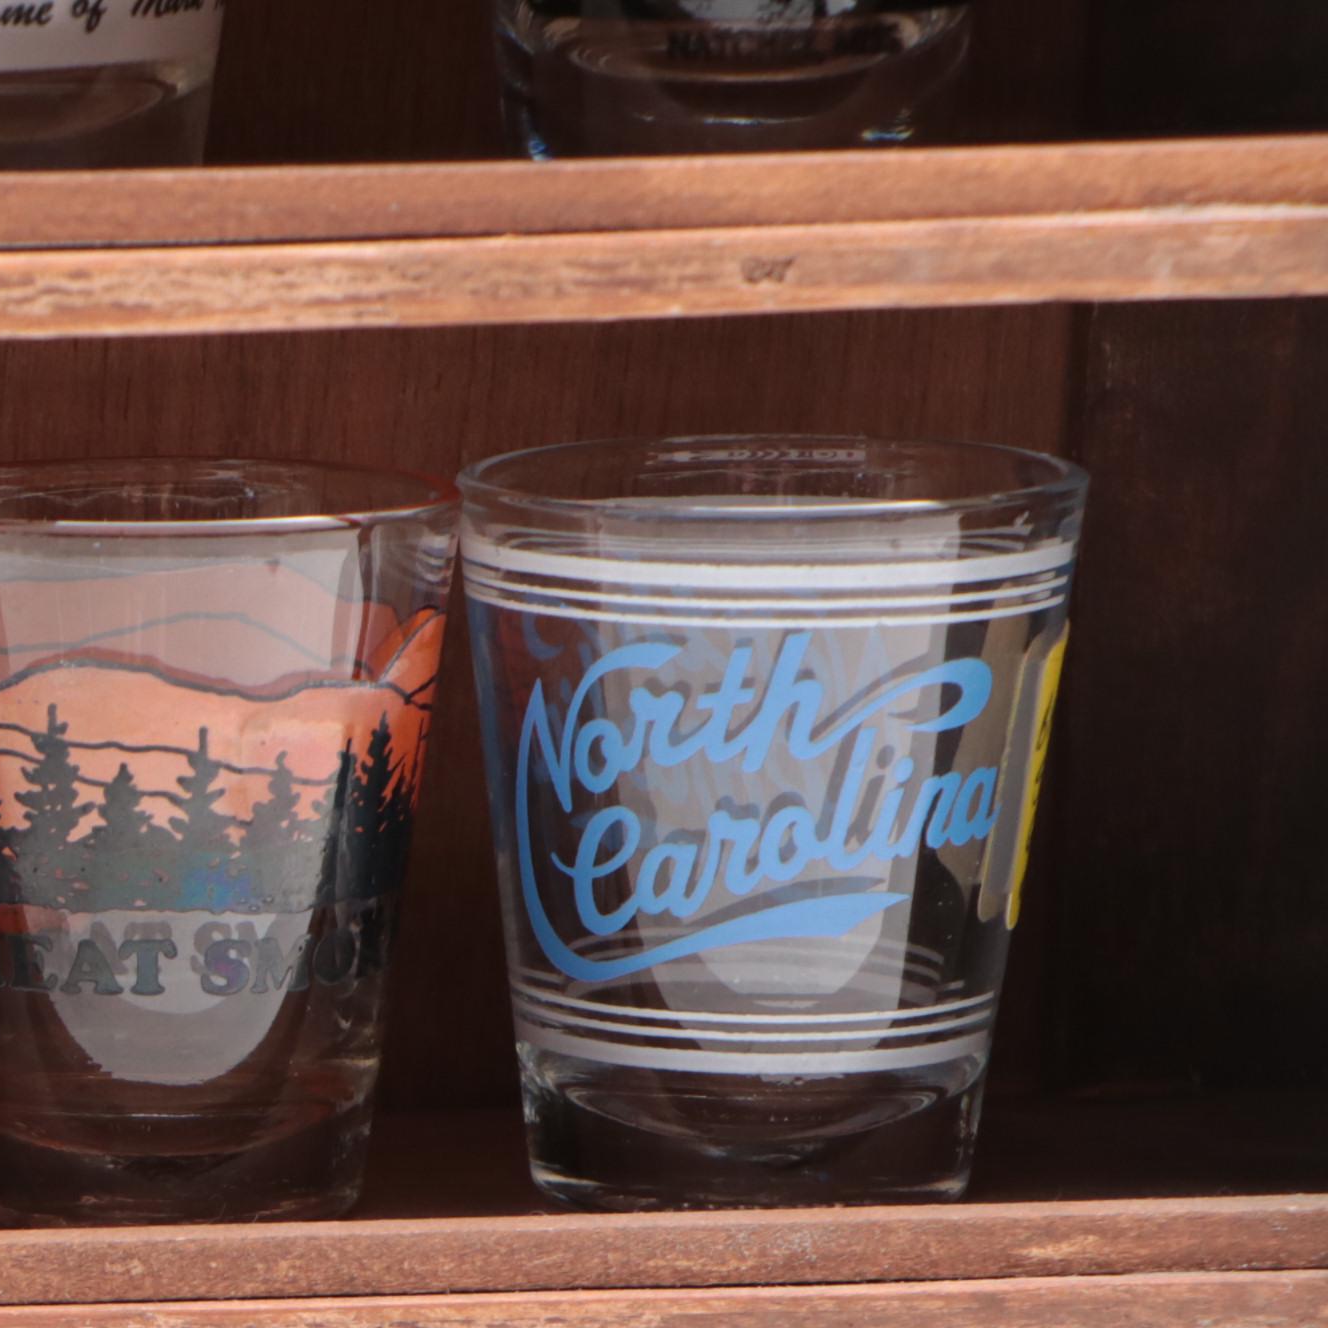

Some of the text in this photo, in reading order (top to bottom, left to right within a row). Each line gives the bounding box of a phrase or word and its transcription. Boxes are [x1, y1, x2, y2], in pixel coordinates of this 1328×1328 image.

[70, 0, 107, 41] of
[518, 629, 984, 812] North
[551, 726, 1000, 936] Carolina
